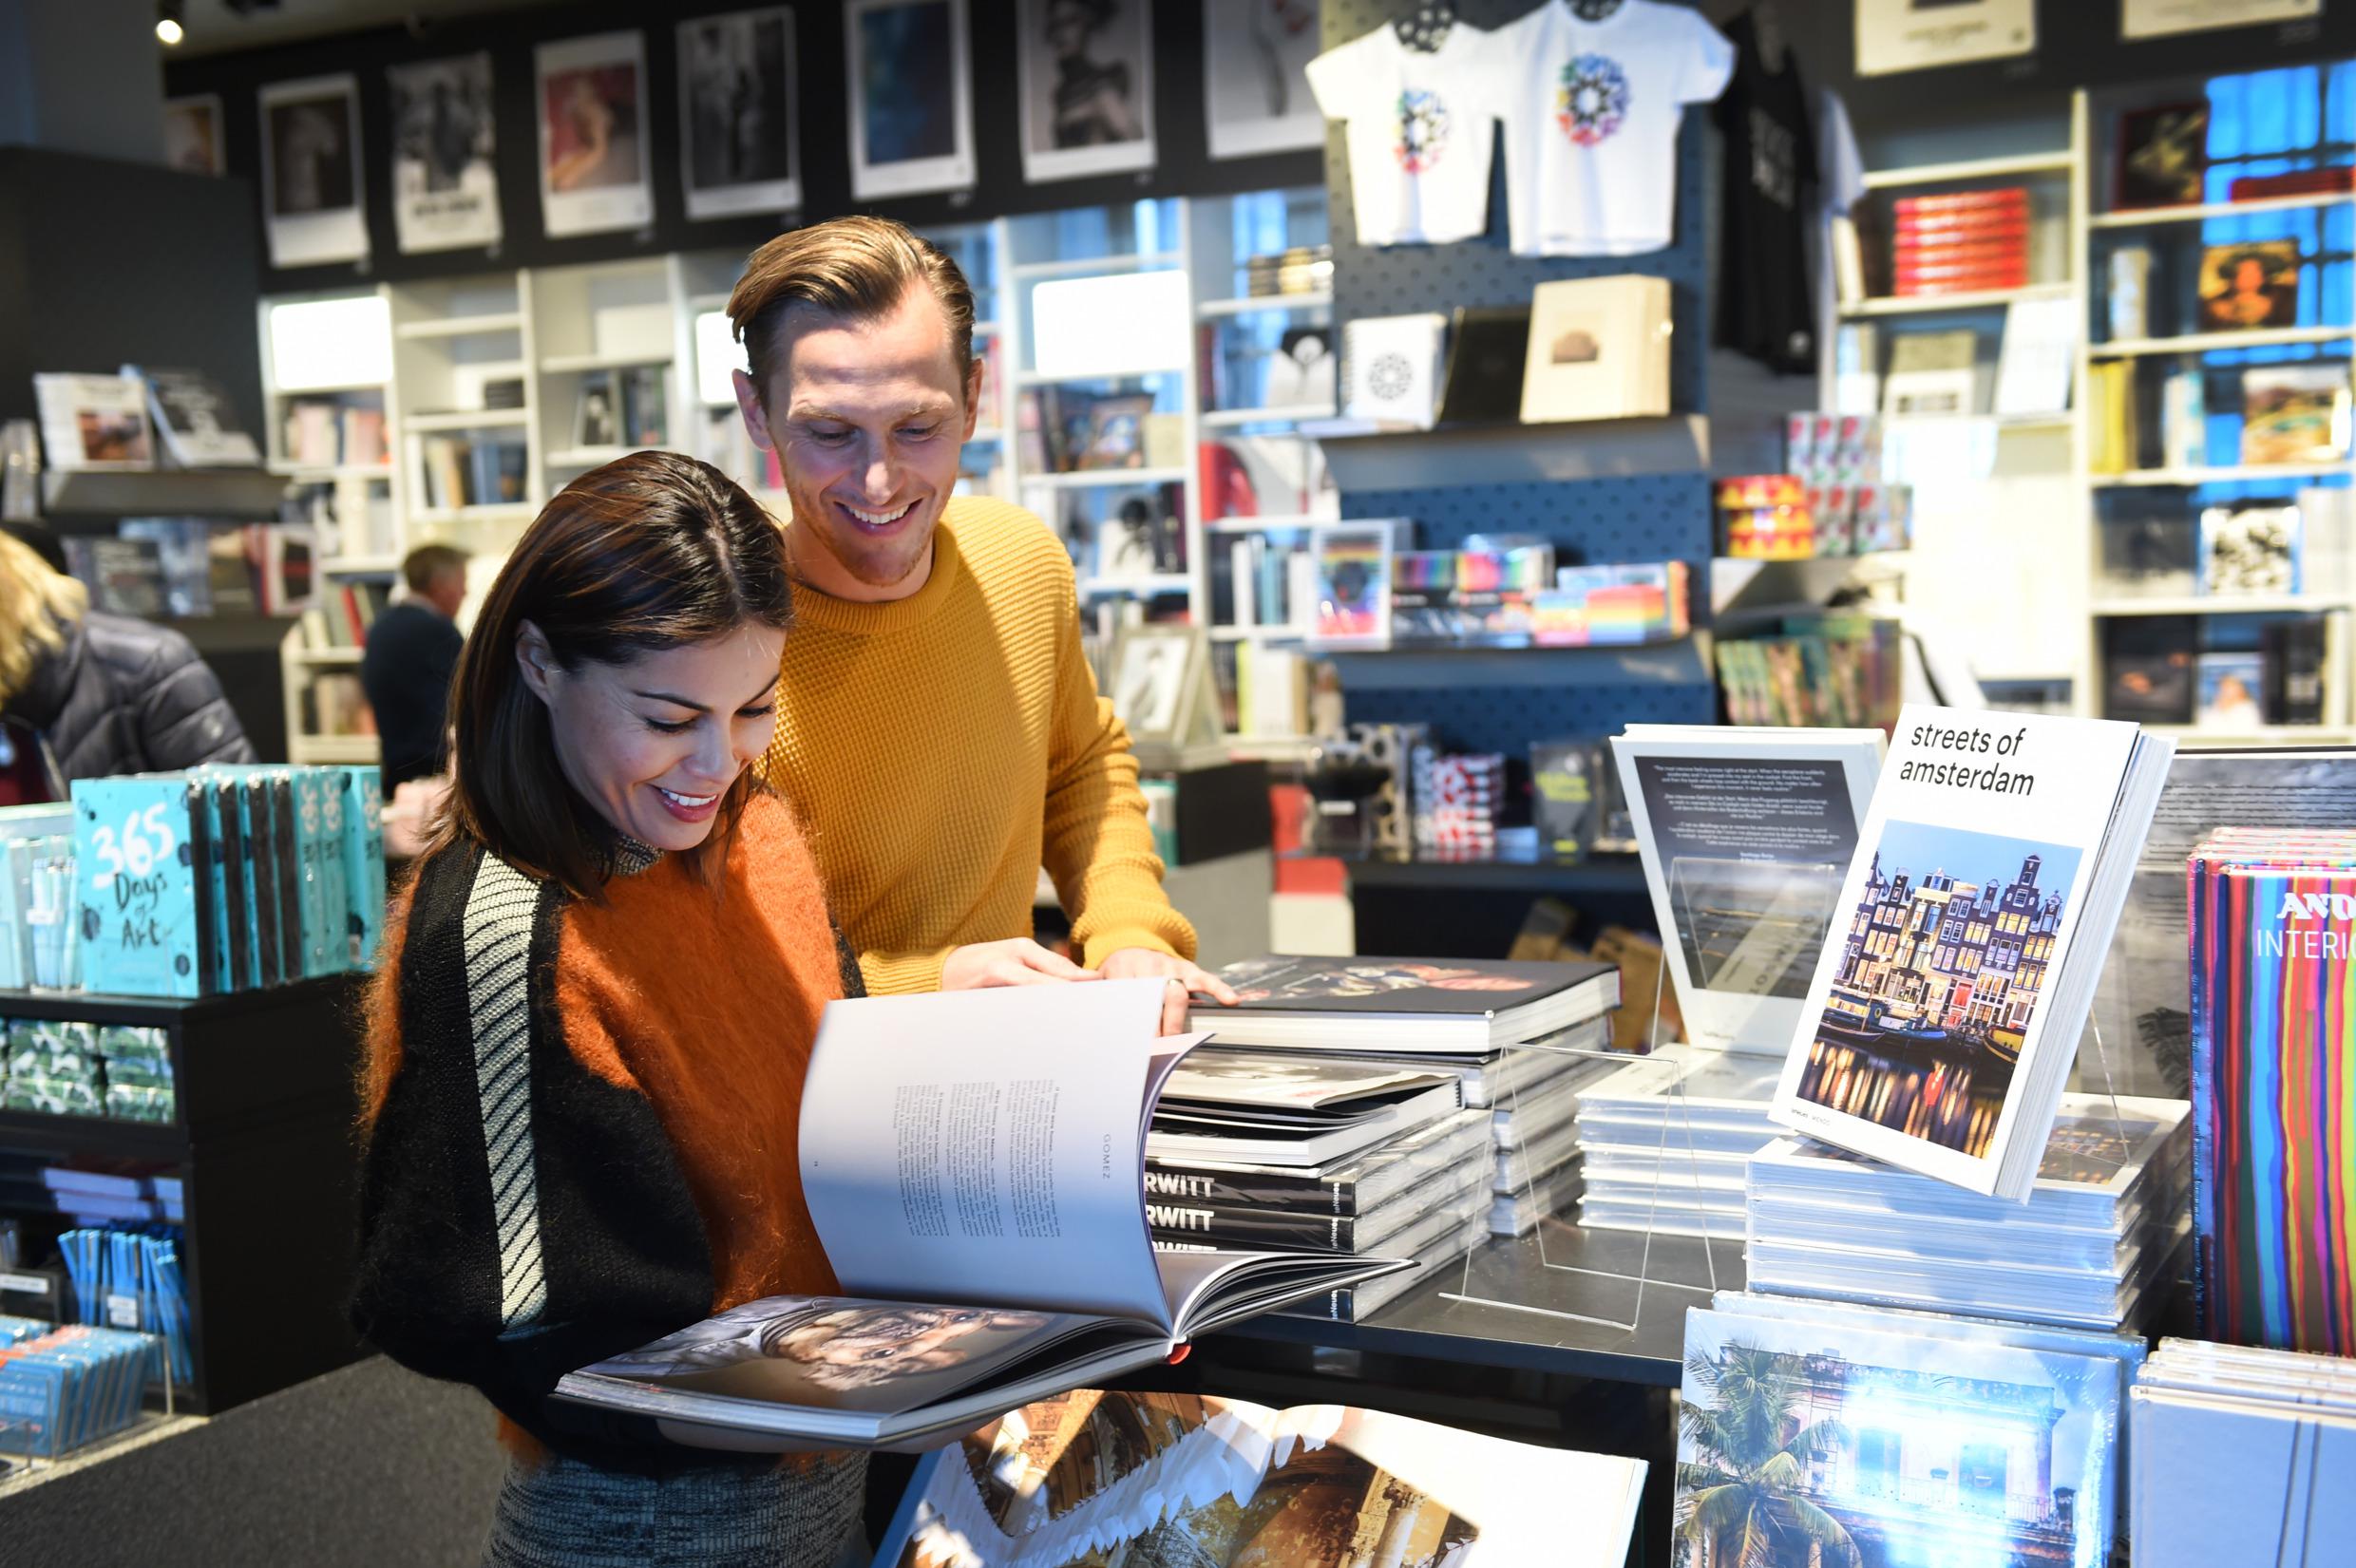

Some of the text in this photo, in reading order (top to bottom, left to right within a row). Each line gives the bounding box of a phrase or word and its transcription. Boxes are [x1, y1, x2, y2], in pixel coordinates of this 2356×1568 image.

[1911, 724, 2026, 756] streets of
[1900, 760, 2035, 796] amsterdam
[91, 802, 175, 889] 365
[114, 871, 167, 914] Days
[2276, 893, 2356, 920] AND
[122, 917, 161, 950] Art
[2257, 930, 2356, 959] INTERI
[1102, 1134, 1111, 1180] GOMEZ
[1144, 1172, 1215, 1198] RWITT
[1146, 1204, 1215, 1232] RWITT
